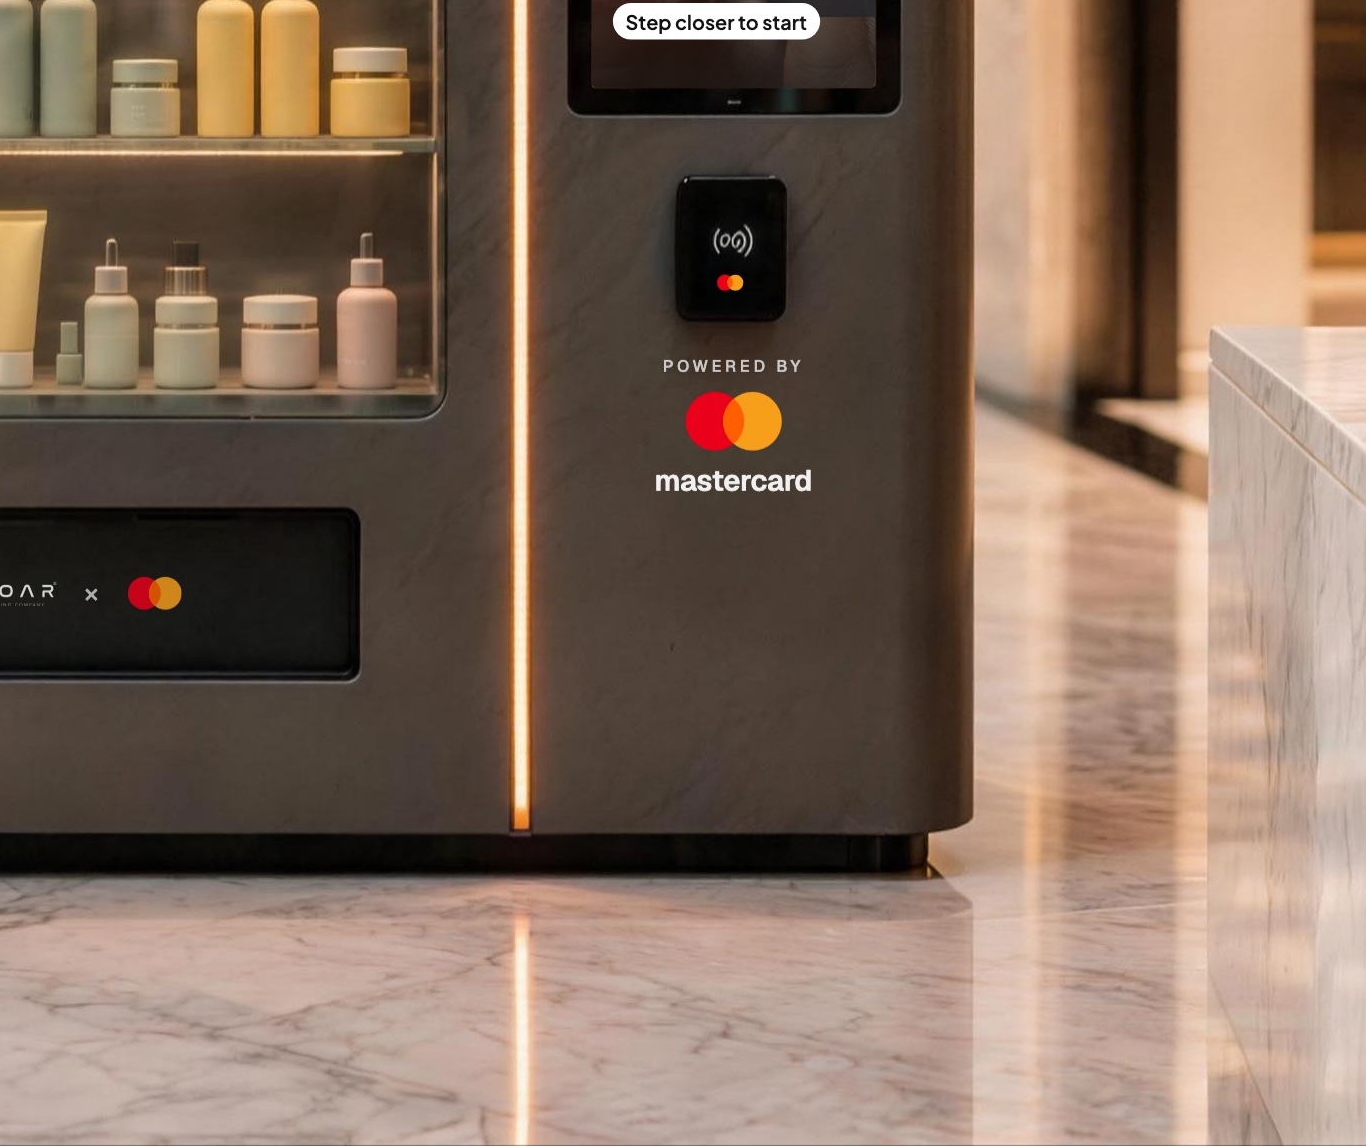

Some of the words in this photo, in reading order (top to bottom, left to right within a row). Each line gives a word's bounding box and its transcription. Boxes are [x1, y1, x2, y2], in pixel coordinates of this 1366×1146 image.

[626, 14, 672, 35] Step
[675, 14, 735, 31] closer
[738, 16, 759, 31] to
[762, 16, 807, 31] start
[663, 359, 766, 373] POWERED
[776, 359, 801, 373] BY
[655, 469, 812, 492] mastercard
